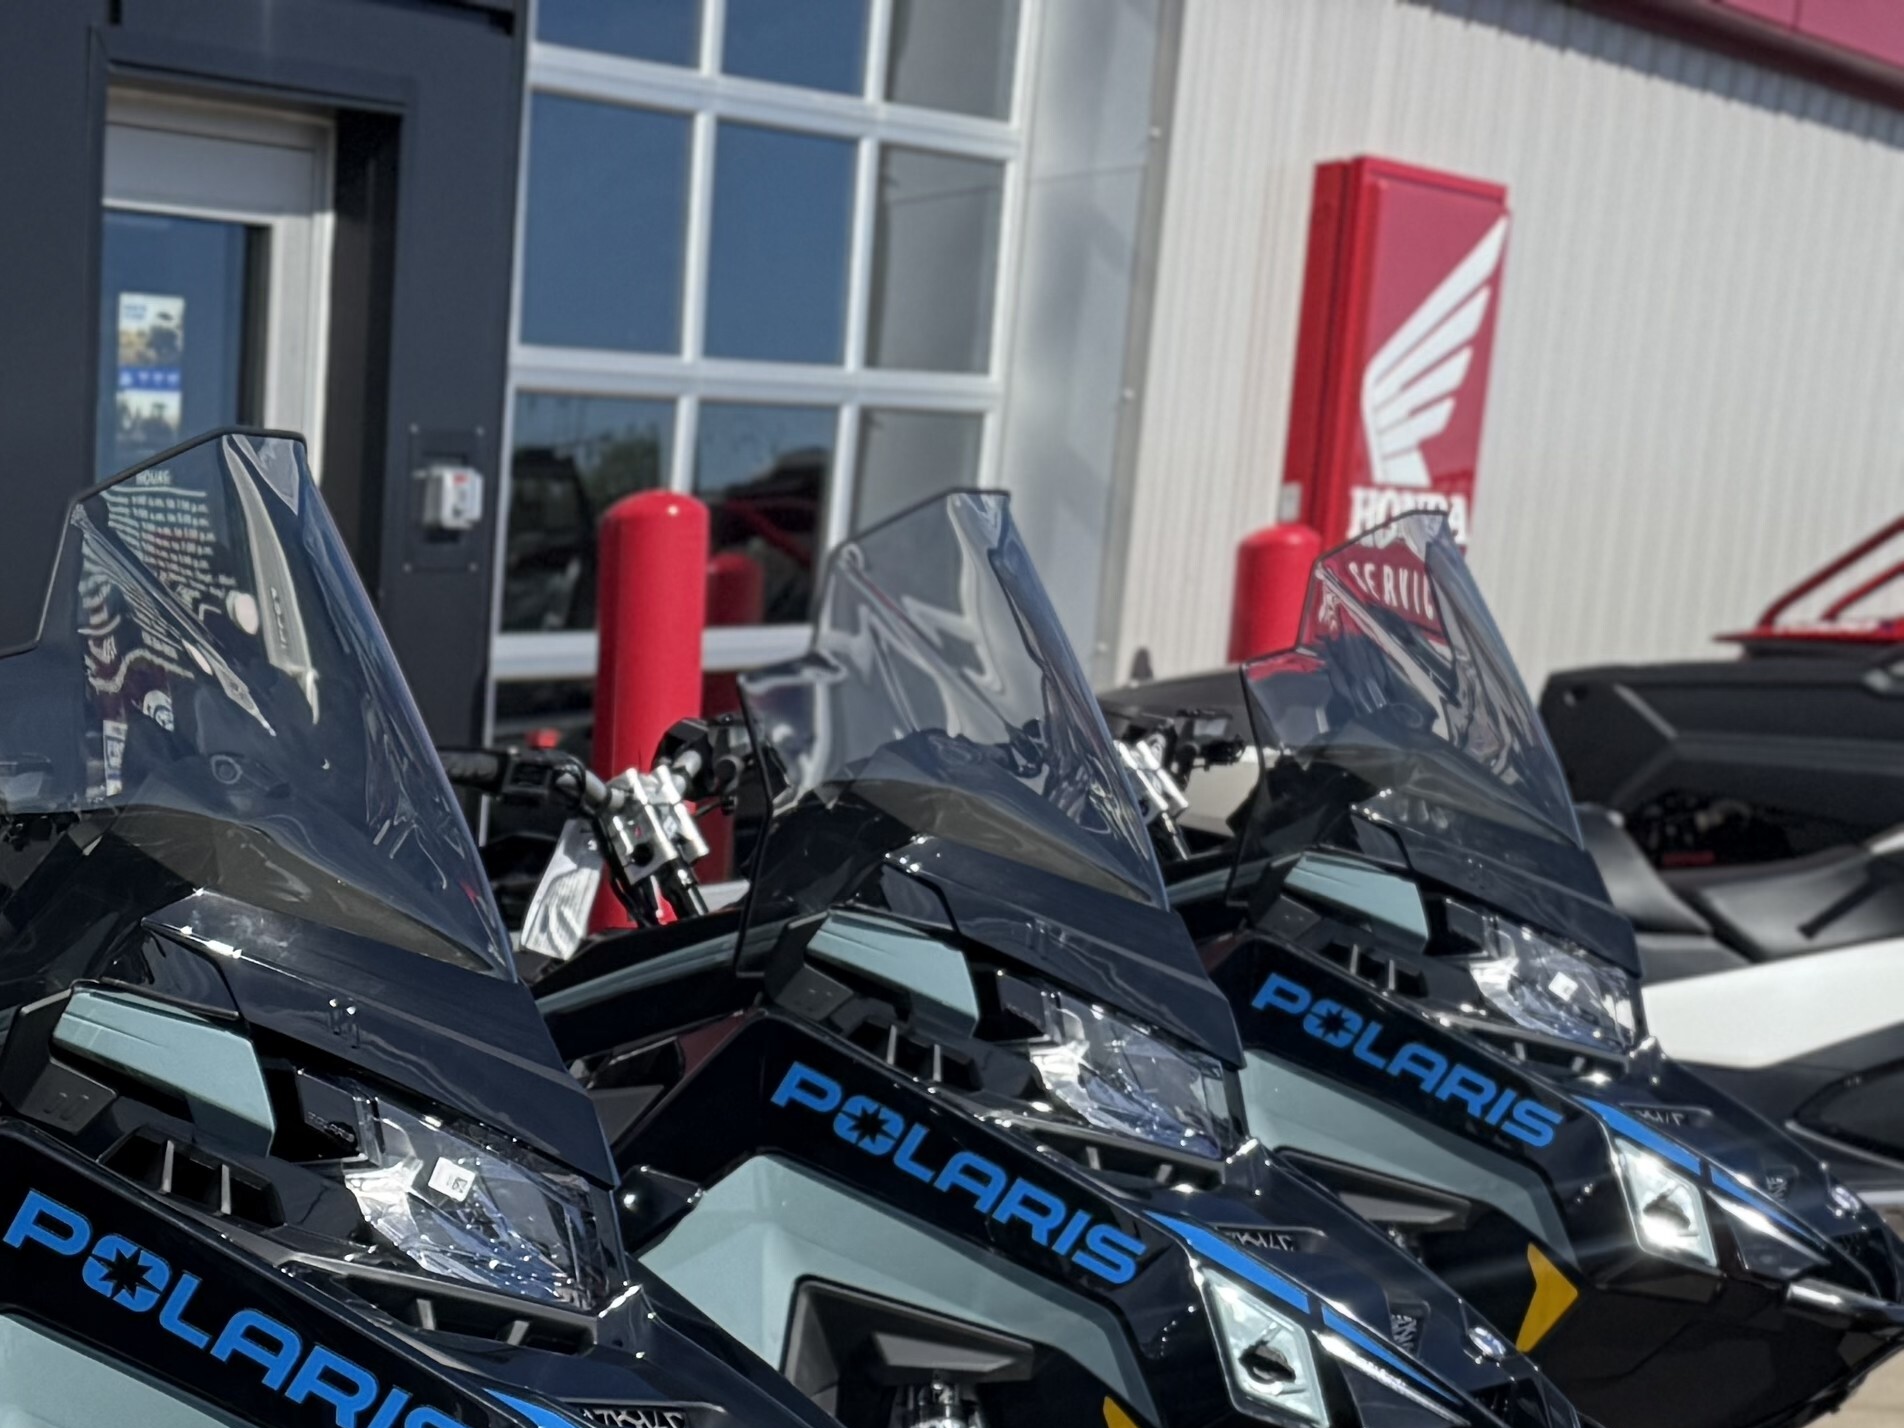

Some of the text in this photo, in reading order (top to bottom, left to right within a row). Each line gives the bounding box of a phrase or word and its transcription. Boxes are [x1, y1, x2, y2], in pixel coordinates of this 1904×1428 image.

[1348, 561, 1434, 621] SERVIC
[1252, 971, 1562, 1150] POLARIS
[771, 1060, 1148, 1288] POLARIS
